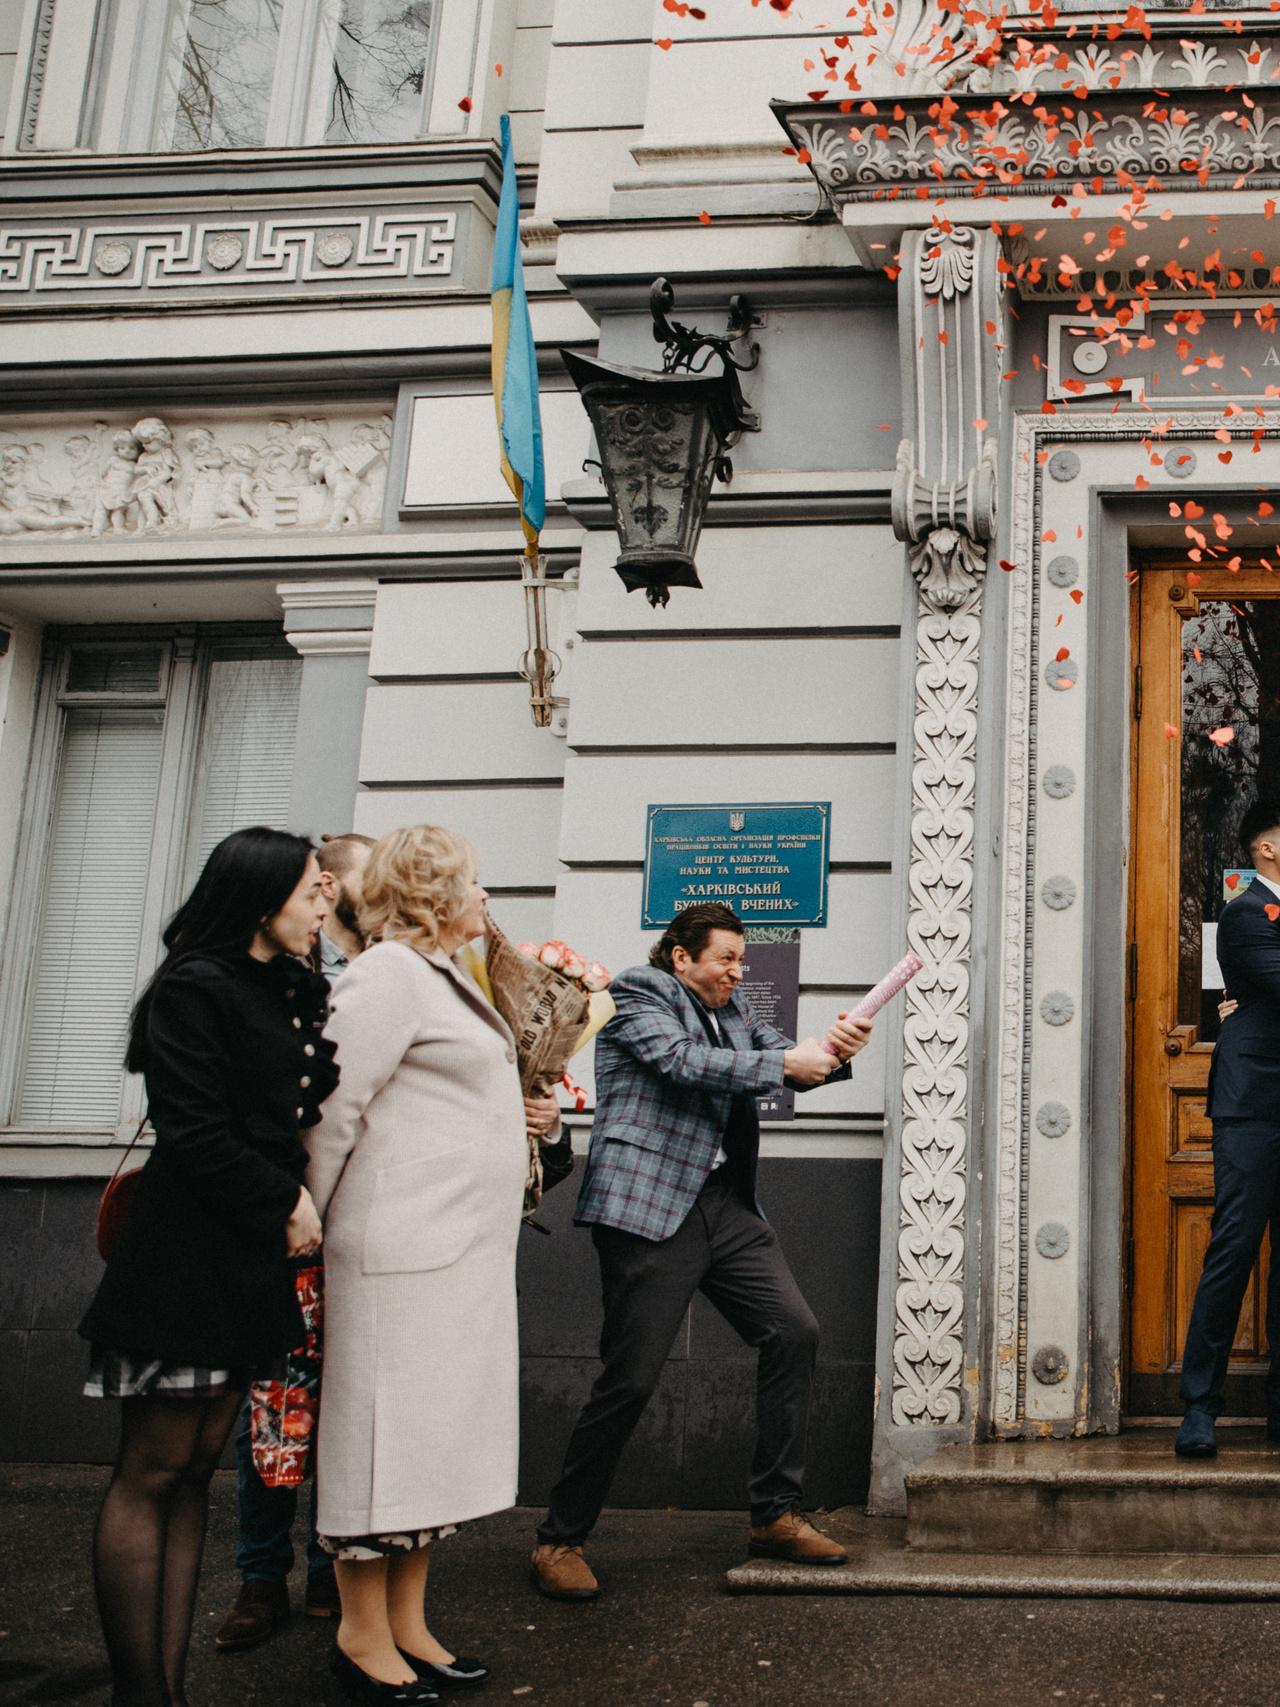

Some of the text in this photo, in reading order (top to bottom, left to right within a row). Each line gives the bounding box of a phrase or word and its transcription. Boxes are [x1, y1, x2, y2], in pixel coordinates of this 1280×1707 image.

[777, 841, 807, 849] УКРАЇНИ
[695, 855, 779, 865] ЦЕНТР КУЛЬТУРИ,
[680, 866, 790, 876] НАУКИ ТА МИСТЕЦТВА
[680, 881, 781, 896] «ХАРКІВСЬКИЙ
[741, 899, 800, 911] ВЧЕНИХ»
[520, 1029, 538, 1051] OLD
